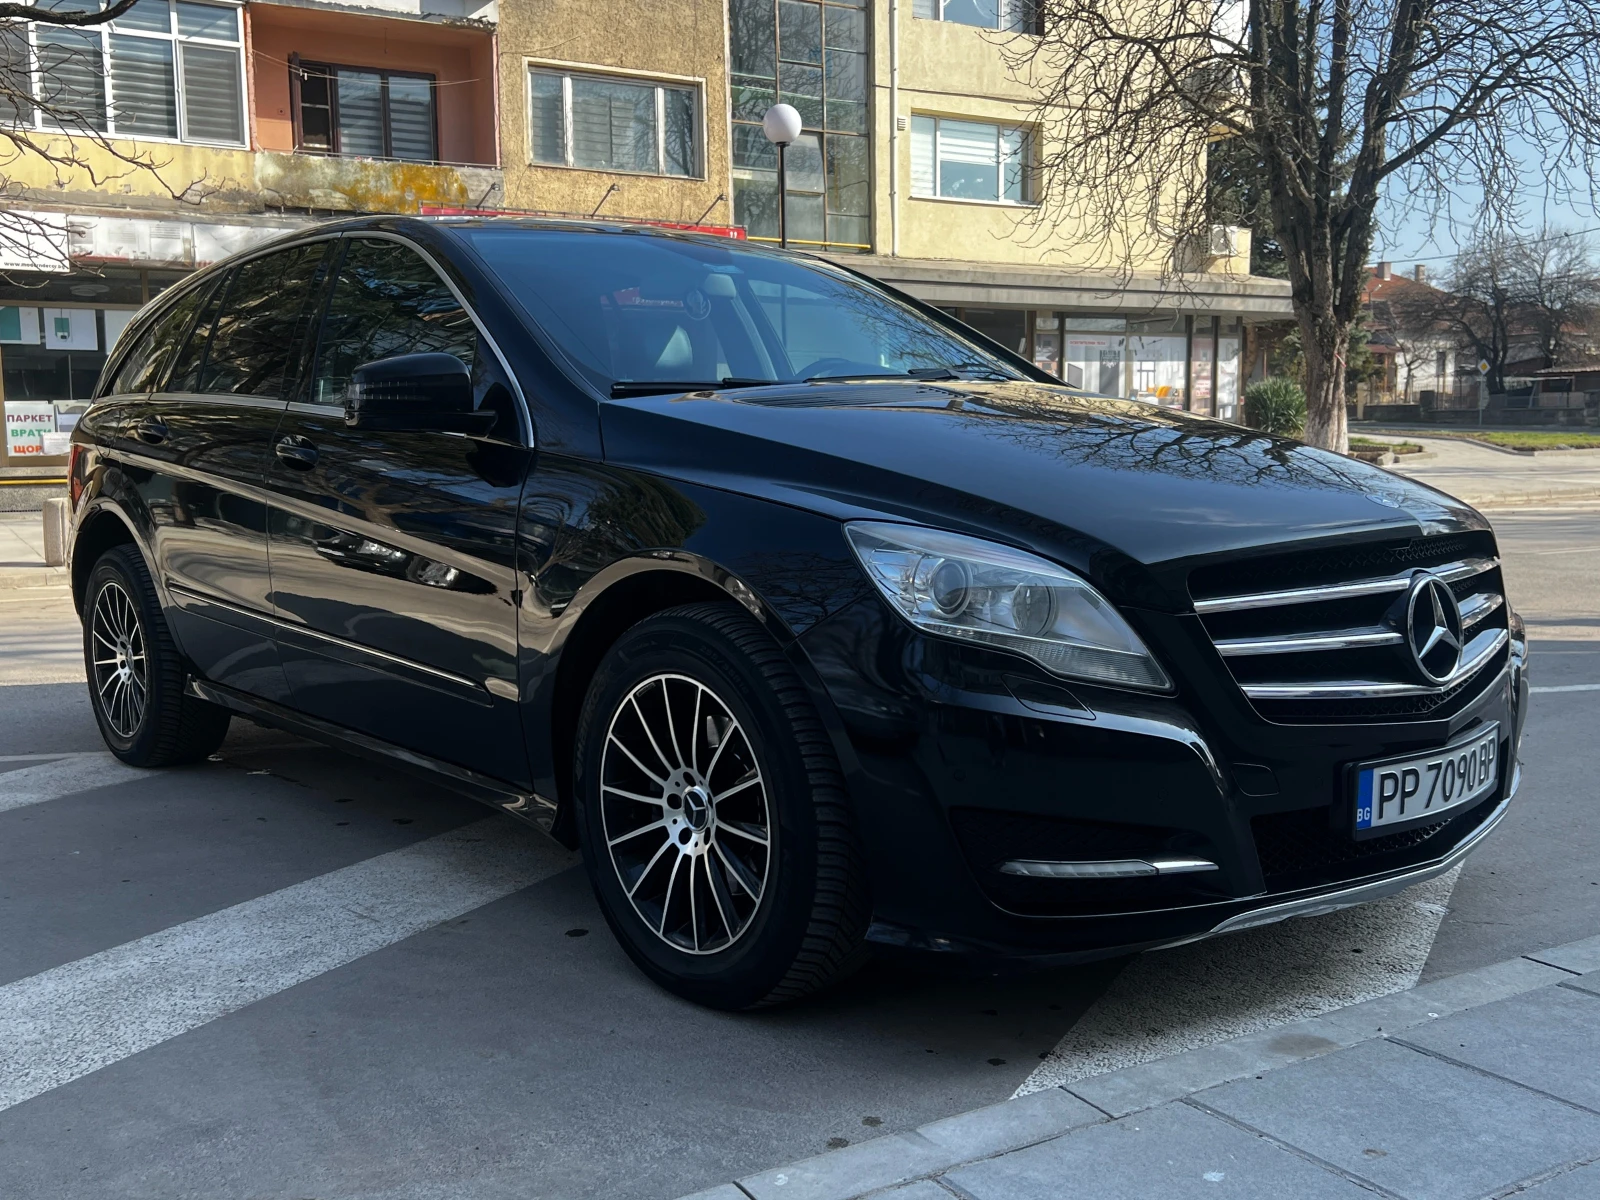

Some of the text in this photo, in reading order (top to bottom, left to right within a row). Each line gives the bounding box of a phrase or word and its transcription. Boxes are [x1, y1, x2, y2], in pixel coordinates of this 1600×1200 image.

[6, 414, 53, 423] ПАРКЕТ
[13, 445, 43, 454] ЩОР
[1377, 736, 1496, 820] PP 7090 BP
[1356, 807, 1371, 822] BG
